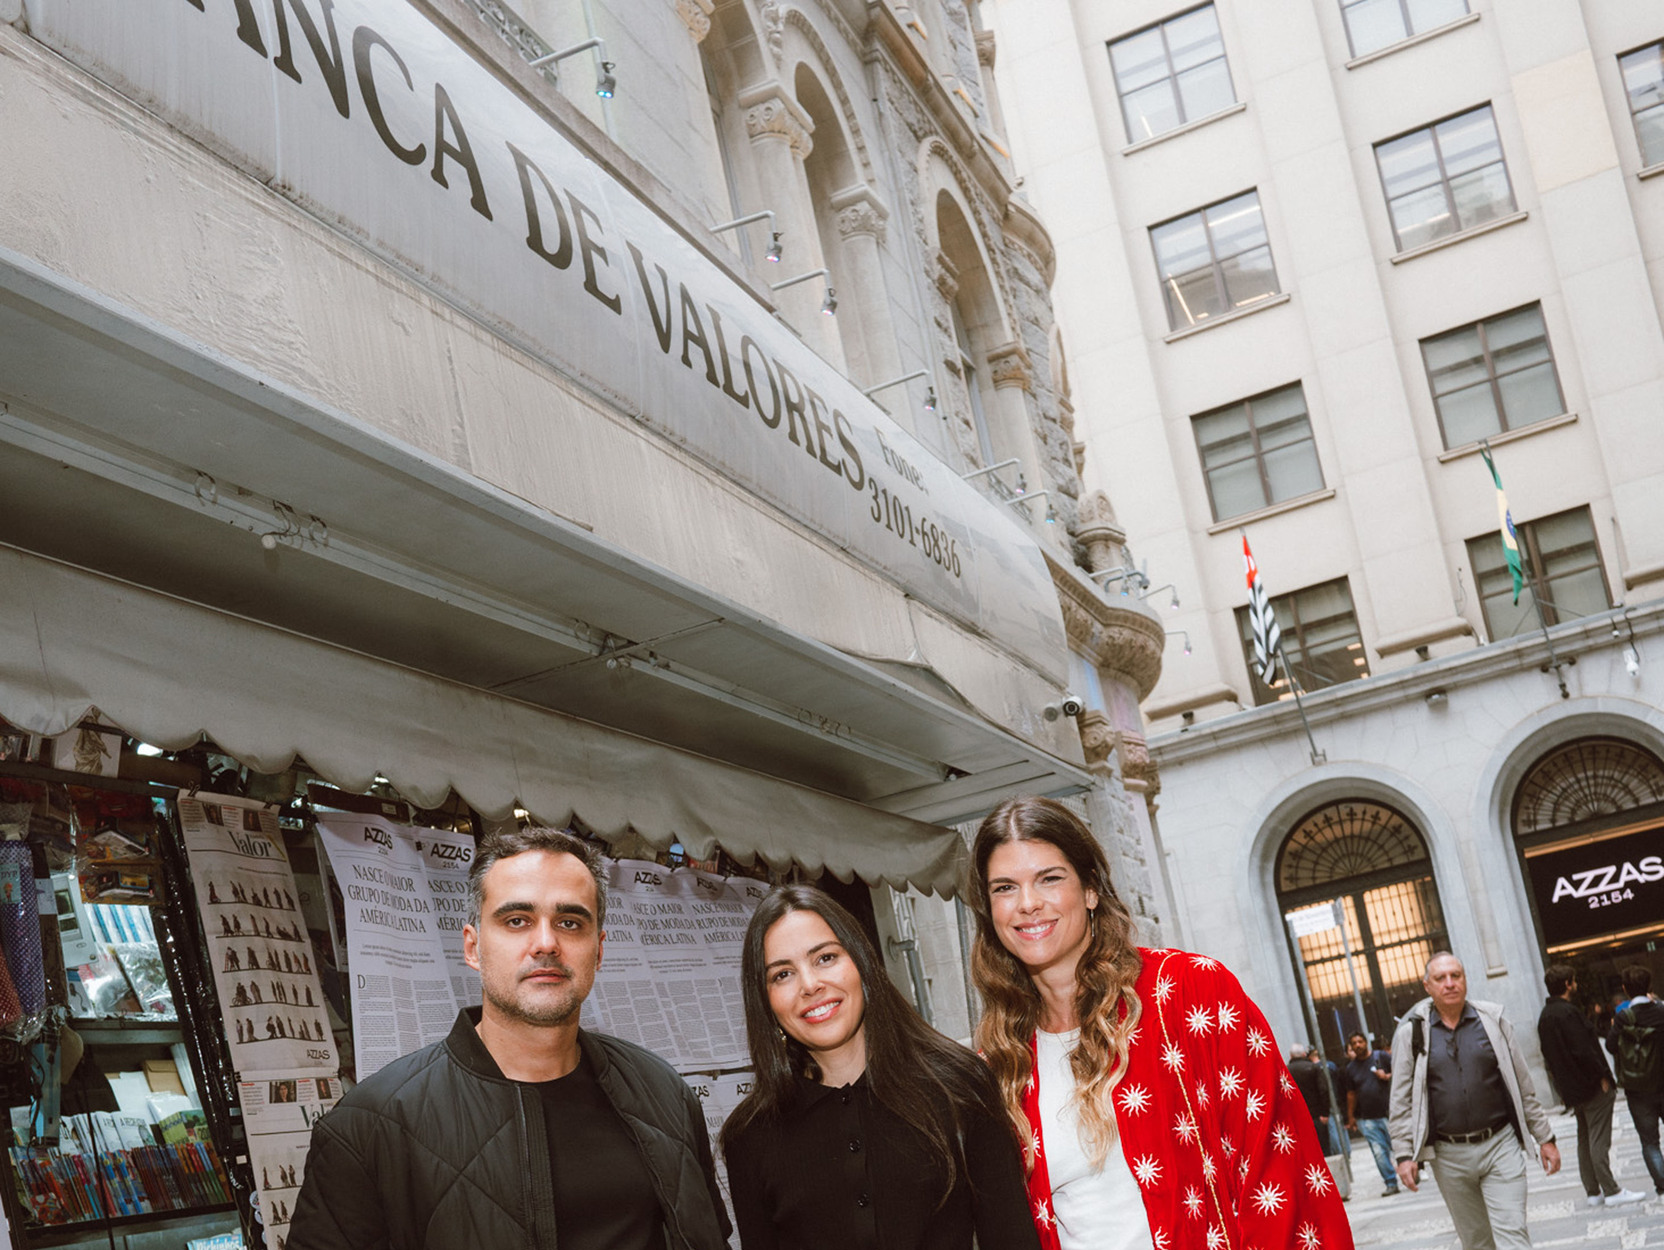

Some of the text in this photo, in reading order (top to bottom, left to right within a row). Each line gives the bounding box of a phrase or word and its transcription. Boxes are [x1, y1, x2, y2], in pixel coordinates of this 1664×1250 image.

[505, 139, 622, 316] DE
[625, 239, 865, 491] VALORES
[868, 476, 962, 578] 3101-6836
[228, 830, 272, 857] Valor
[430, 842, 472, 862] AZZAS
[352, 864, 385, 884] NASCE
[1551, 856, 1664, 904] AZZAS
[347, 884, 380, 904] GRUPO
[413, 898, 431, 913] DA
[1588, 888, 1635, 909] 2154
